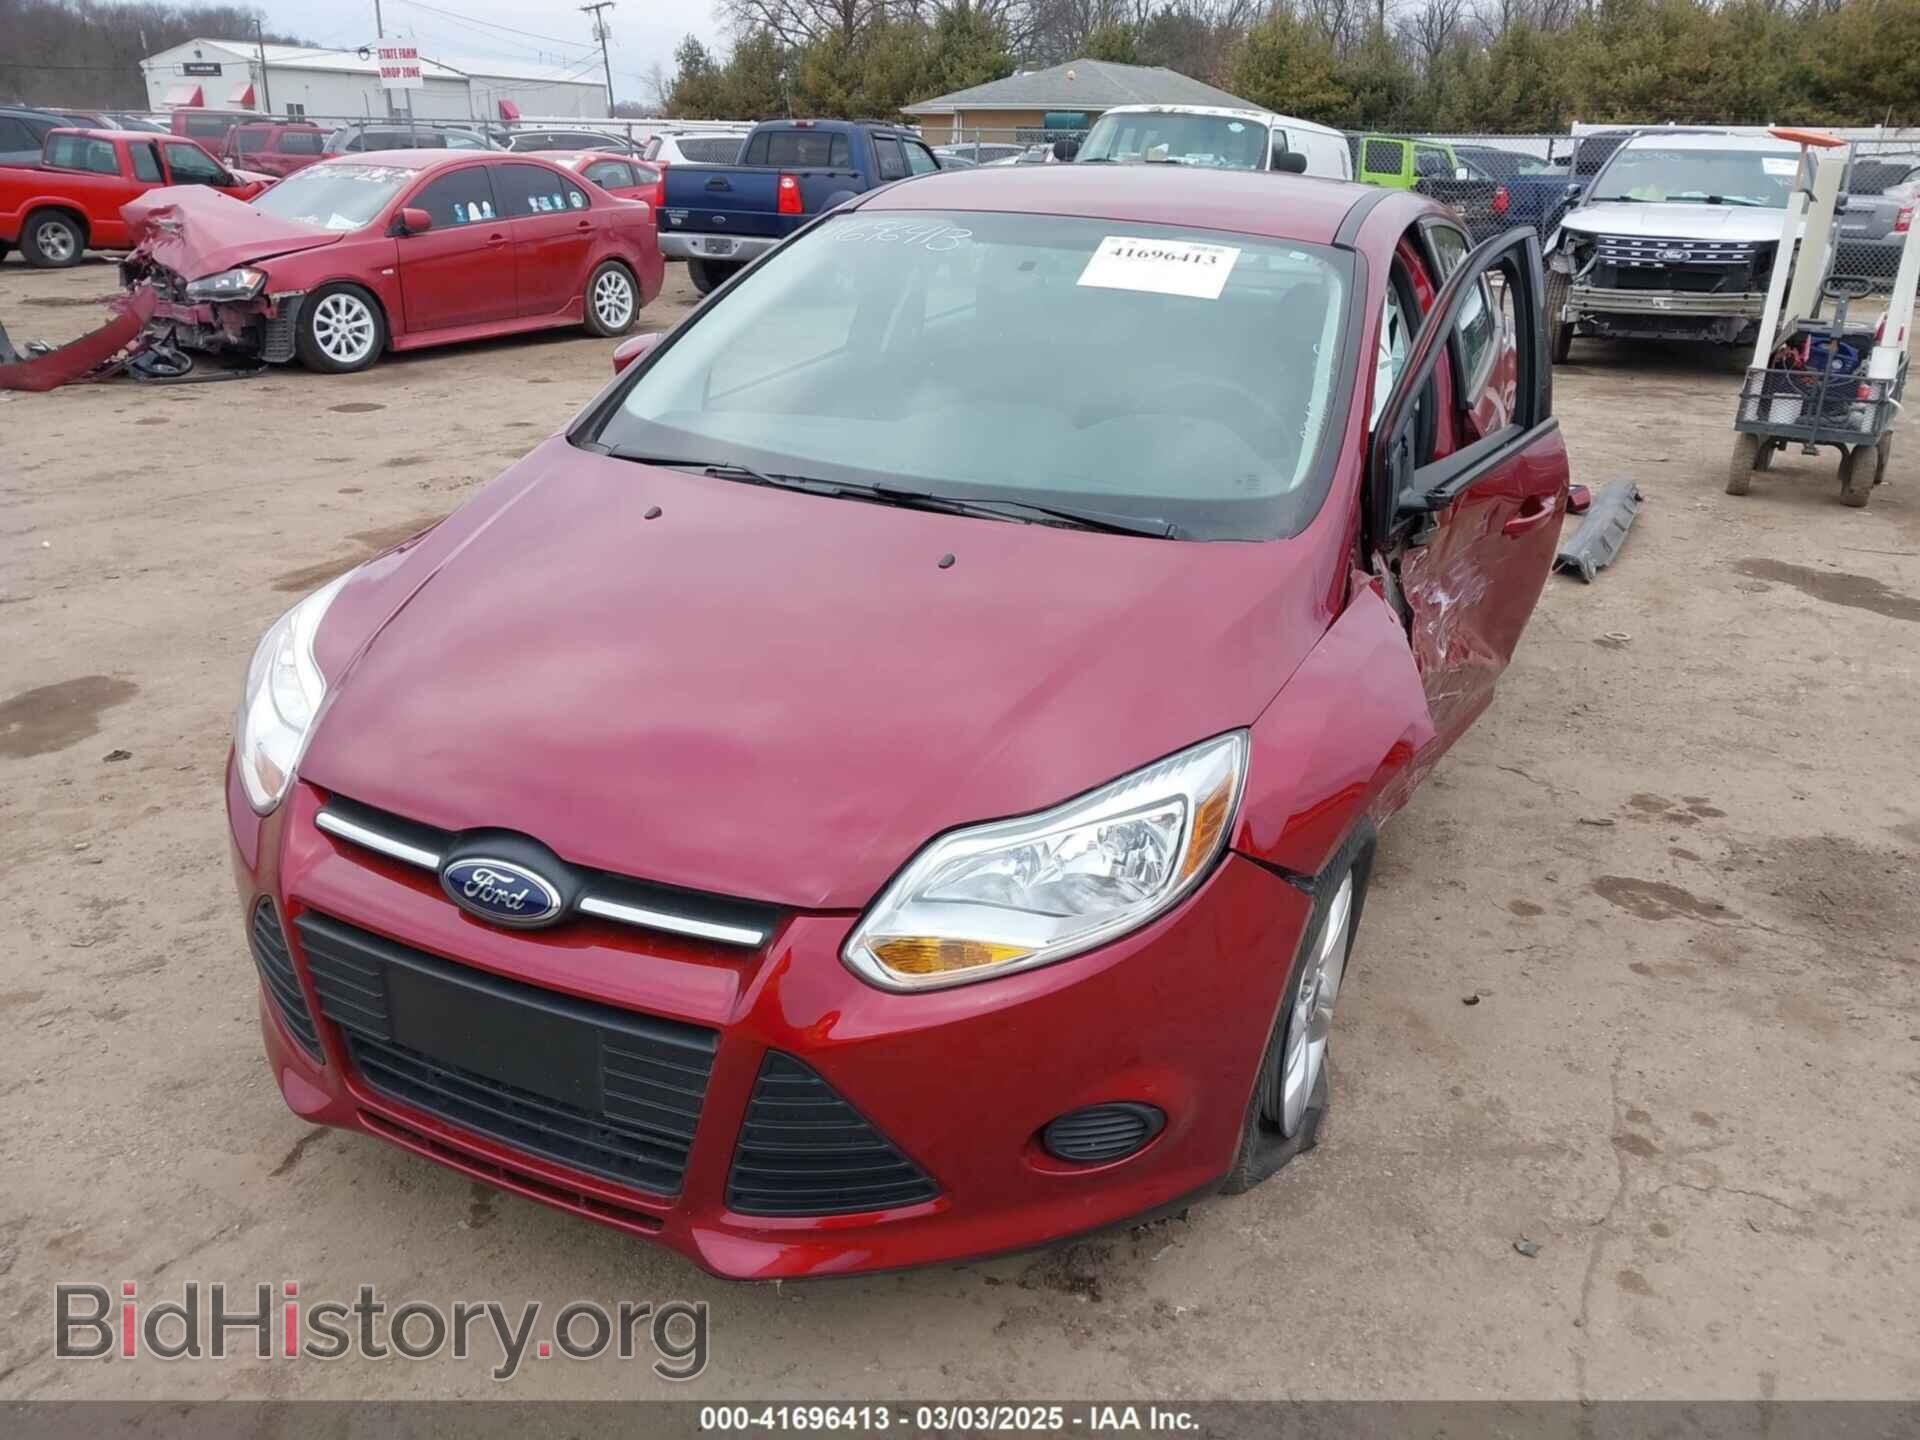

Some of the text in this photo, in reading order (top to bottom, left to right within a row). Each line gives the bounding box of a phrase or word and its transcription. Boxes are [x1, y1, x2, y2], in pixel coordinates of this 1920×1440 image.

[378, 48, 417, 59] STATE FARM
[381, 67, 420, 78] DROP ZONE
[1110, 247, 1217, 265] 41696413
[464, 868, 529, 910] Ford
